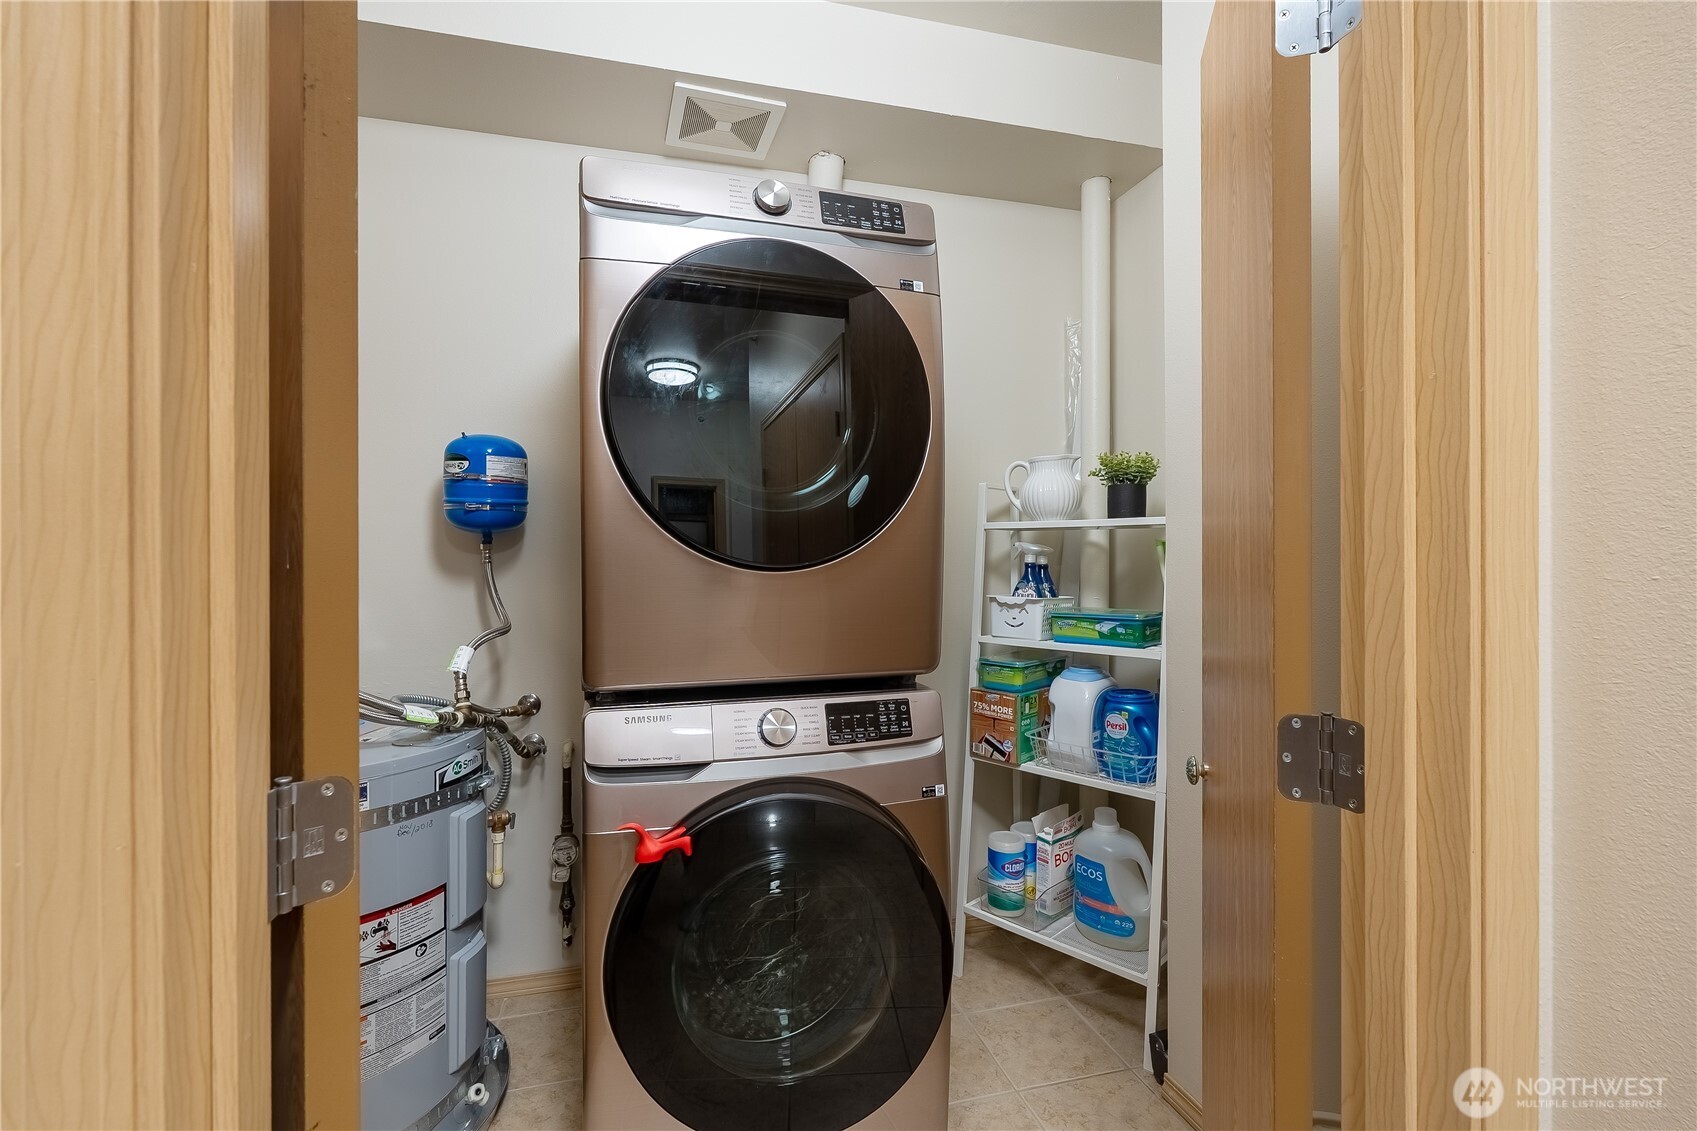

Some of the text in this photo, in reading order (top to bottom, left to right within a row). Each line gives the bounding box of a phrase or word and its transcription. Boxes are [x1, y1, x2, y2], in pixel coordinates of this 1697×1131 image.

[973, 701, 1013, 715] 75% MORE
[624, 714, 672, 725] SAMSUNG
[1106, 719, 1126, 731] Persil
[1054, 849, 1073, 867] BOR
[1076, 862, 1103, 881] ECOS
[391, 903, 413, 914] DANGER
